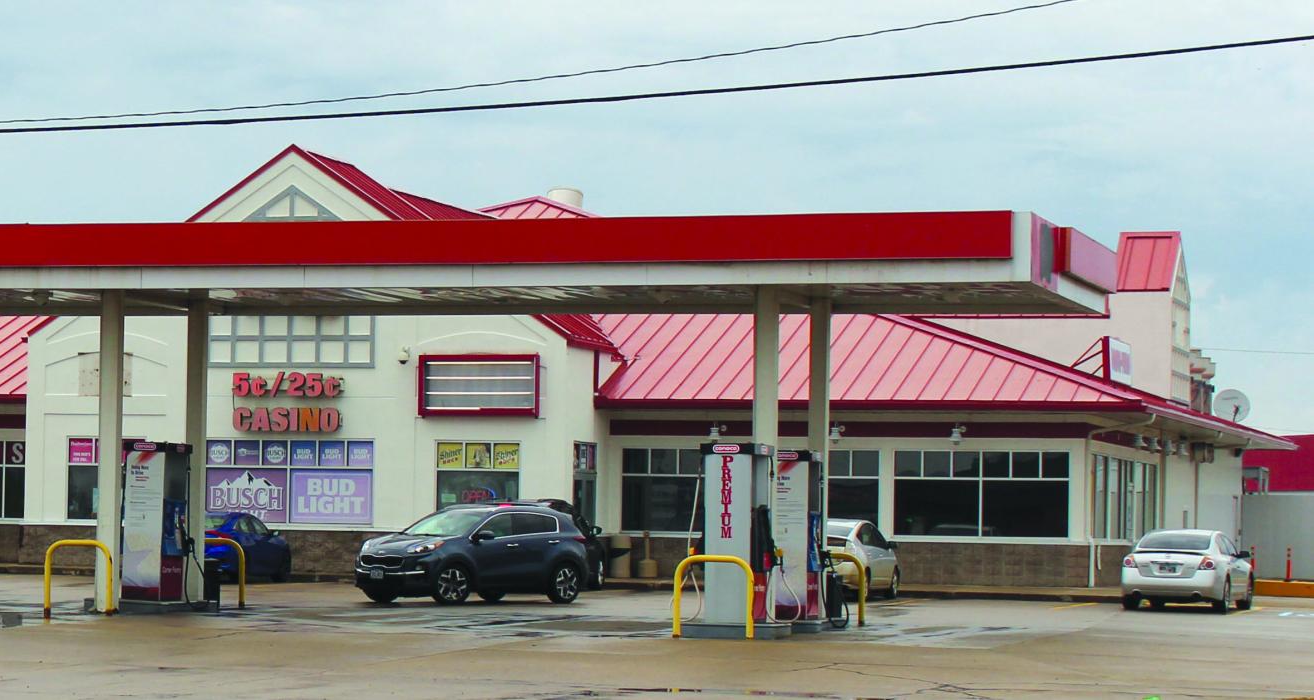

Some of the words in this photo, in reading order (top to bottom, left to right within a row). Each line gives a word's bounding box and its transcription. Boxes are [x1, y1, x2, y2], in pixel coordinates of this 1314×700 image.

[232, 407, 341, 432] CASINO
[211, 486, 283, 509] BUSCH
[307, 478, 356, 496] BUD
[721, 456, 734, 539] PREMIUM
[297, 496, 364, 514] LIGHT
